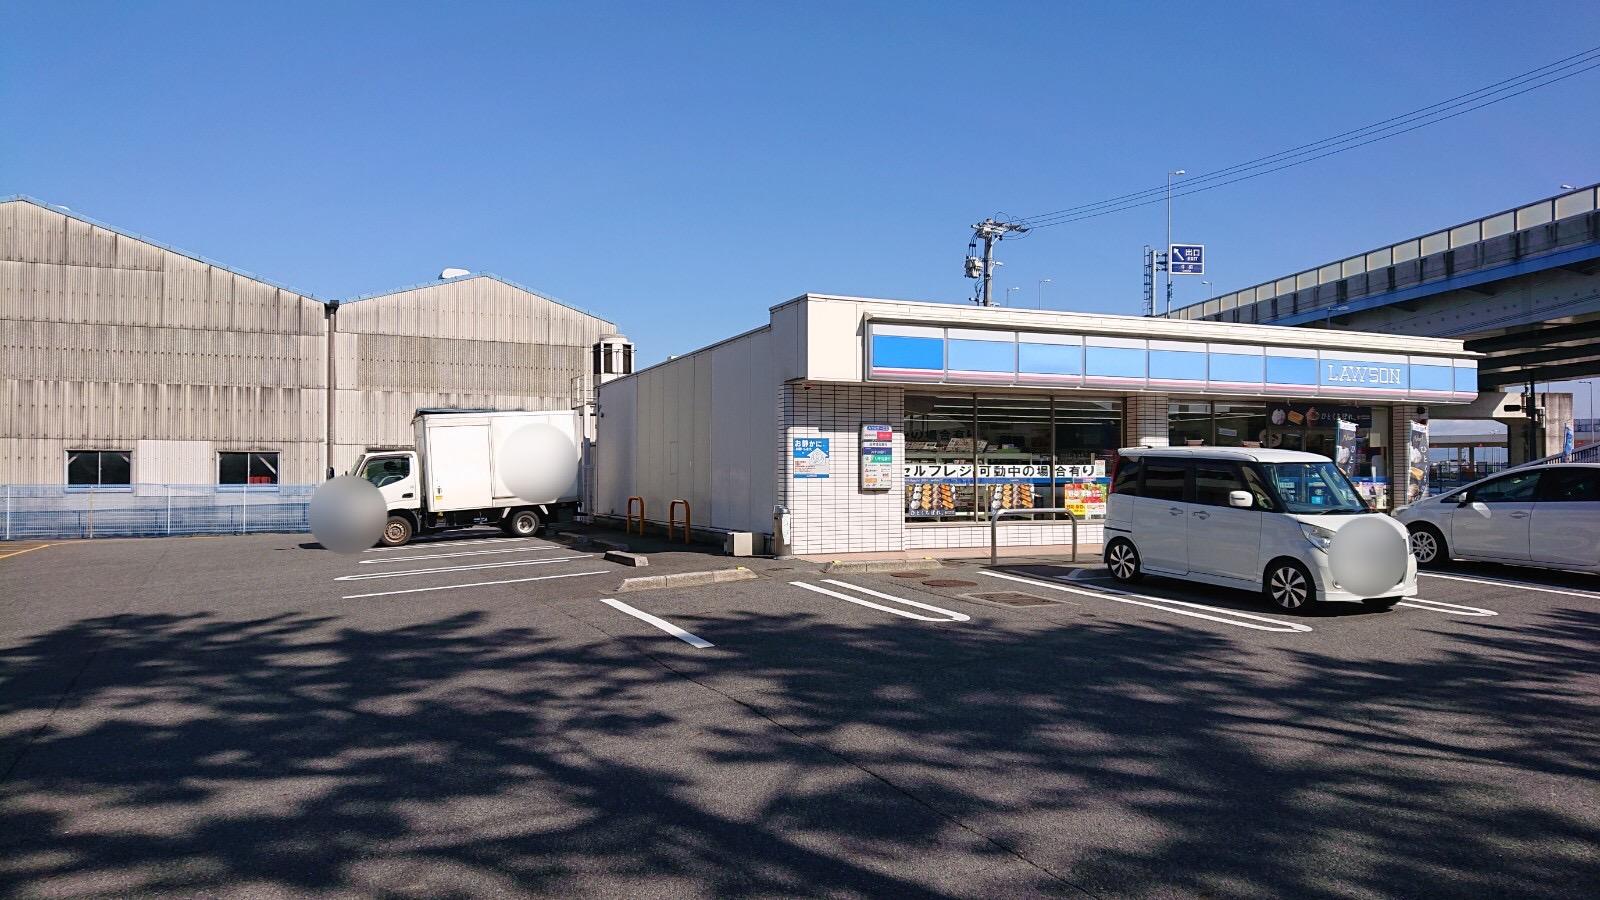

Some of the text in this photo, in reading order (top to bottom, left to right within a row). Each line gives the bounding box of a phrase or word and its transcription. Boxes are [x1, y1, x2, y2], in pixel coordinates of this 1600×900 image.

[1185, 248, 1200, 256] 出口
[1327, 364, 1401, 385] LAWSON
[794, 439, 822, 448] お静かに
